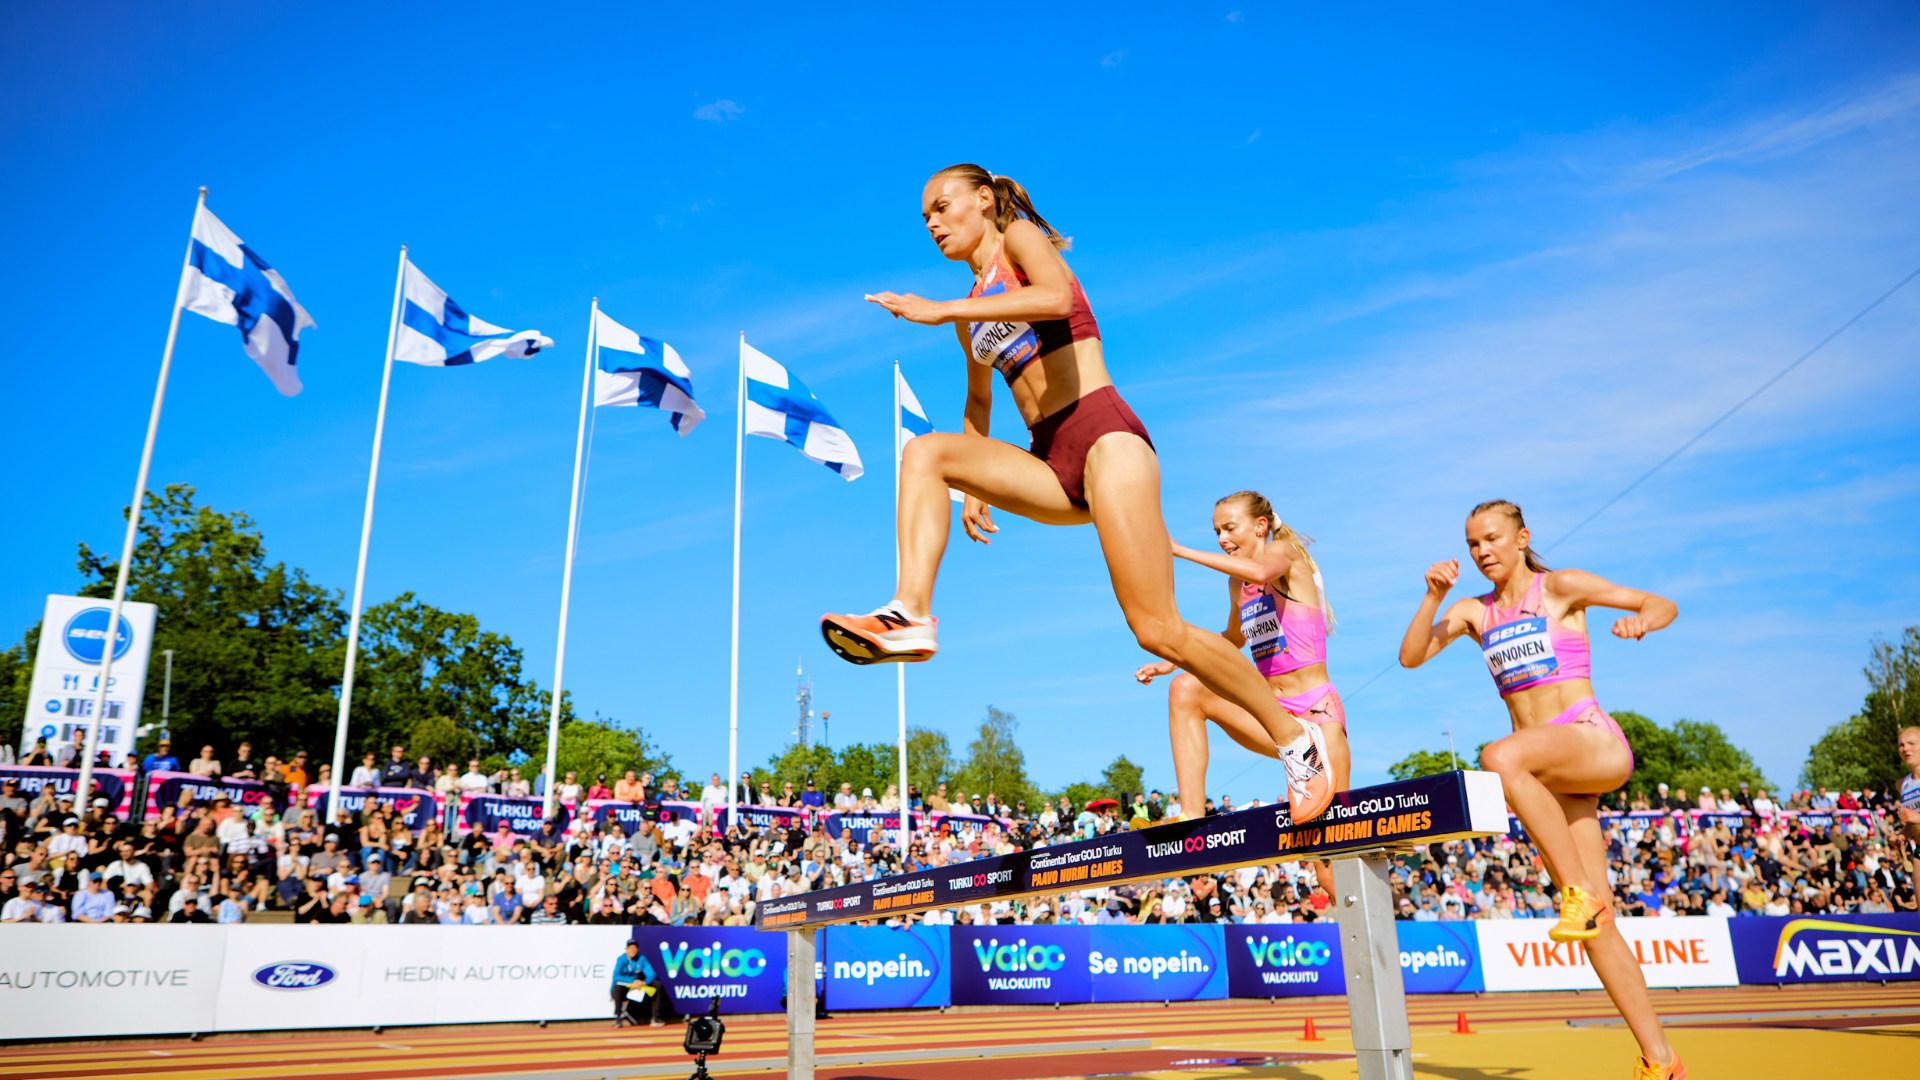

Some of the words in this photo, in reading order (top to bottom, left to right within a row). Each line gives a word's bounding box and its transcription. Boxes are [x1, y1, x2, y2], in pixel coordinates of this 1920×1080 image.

[1489, 639, 1545, 668] MONONEN
[484, 802, 532, 818] TURKU
[1334, 804, 1358, 819] Tour
[1359, 796, 1395, 815] GOLD
[1395, 792, 1429, 808] Turku
[1278, 827, 1322, 851] PAAVO
[1324, 818, 1372, 844] NURMI
[1376, 810, 1431, 837] GAMES
[1146, 840, 1183, 858] TURKU
[1206, 829, 1247, 849] SPORT
[1030, 855, 1066, 870] Continental
[1065, 852, 1081, 864] Tour
[1080, 846, 1103, 861] GOLD
[1102, 845, 1122, 857] Turku
[906, 880, 922, 891] GOLD
[921, 878, 934, 888] Turku
[949, 875, 973, 890] TURKU
[987, 869, 1013, 884] SPORT
[1031, 869, 1059, 887] PAAVO
[1059, 864, 1089, 883] NURMI
[1090, 859, 1123, 878] GAMES
[843, 895, 861, 908] SPORT
[873, 896, 892, 910] PAAVO
[912, 889, 935, 905] GAMES
[1400, 944, 1467, 974] opein.
[1637, 938, 1709, 965] LINE
[266, 963, 323, 987] Ford
[385, 966, 457, 982] HEDIN
[464, 964, 606, 981] AUTOMOTIVE
[834, 952, 931, 985] nopein.
[1088, 951, 1118, 974] Se
[1123, 950, 1209, 980] nopein.
[1261, 970, 1319, 984] VALOKUITU
[674, 984, 748, 999] VALOKUITU
[988, 977, 1051, 990] VALOKUITU
